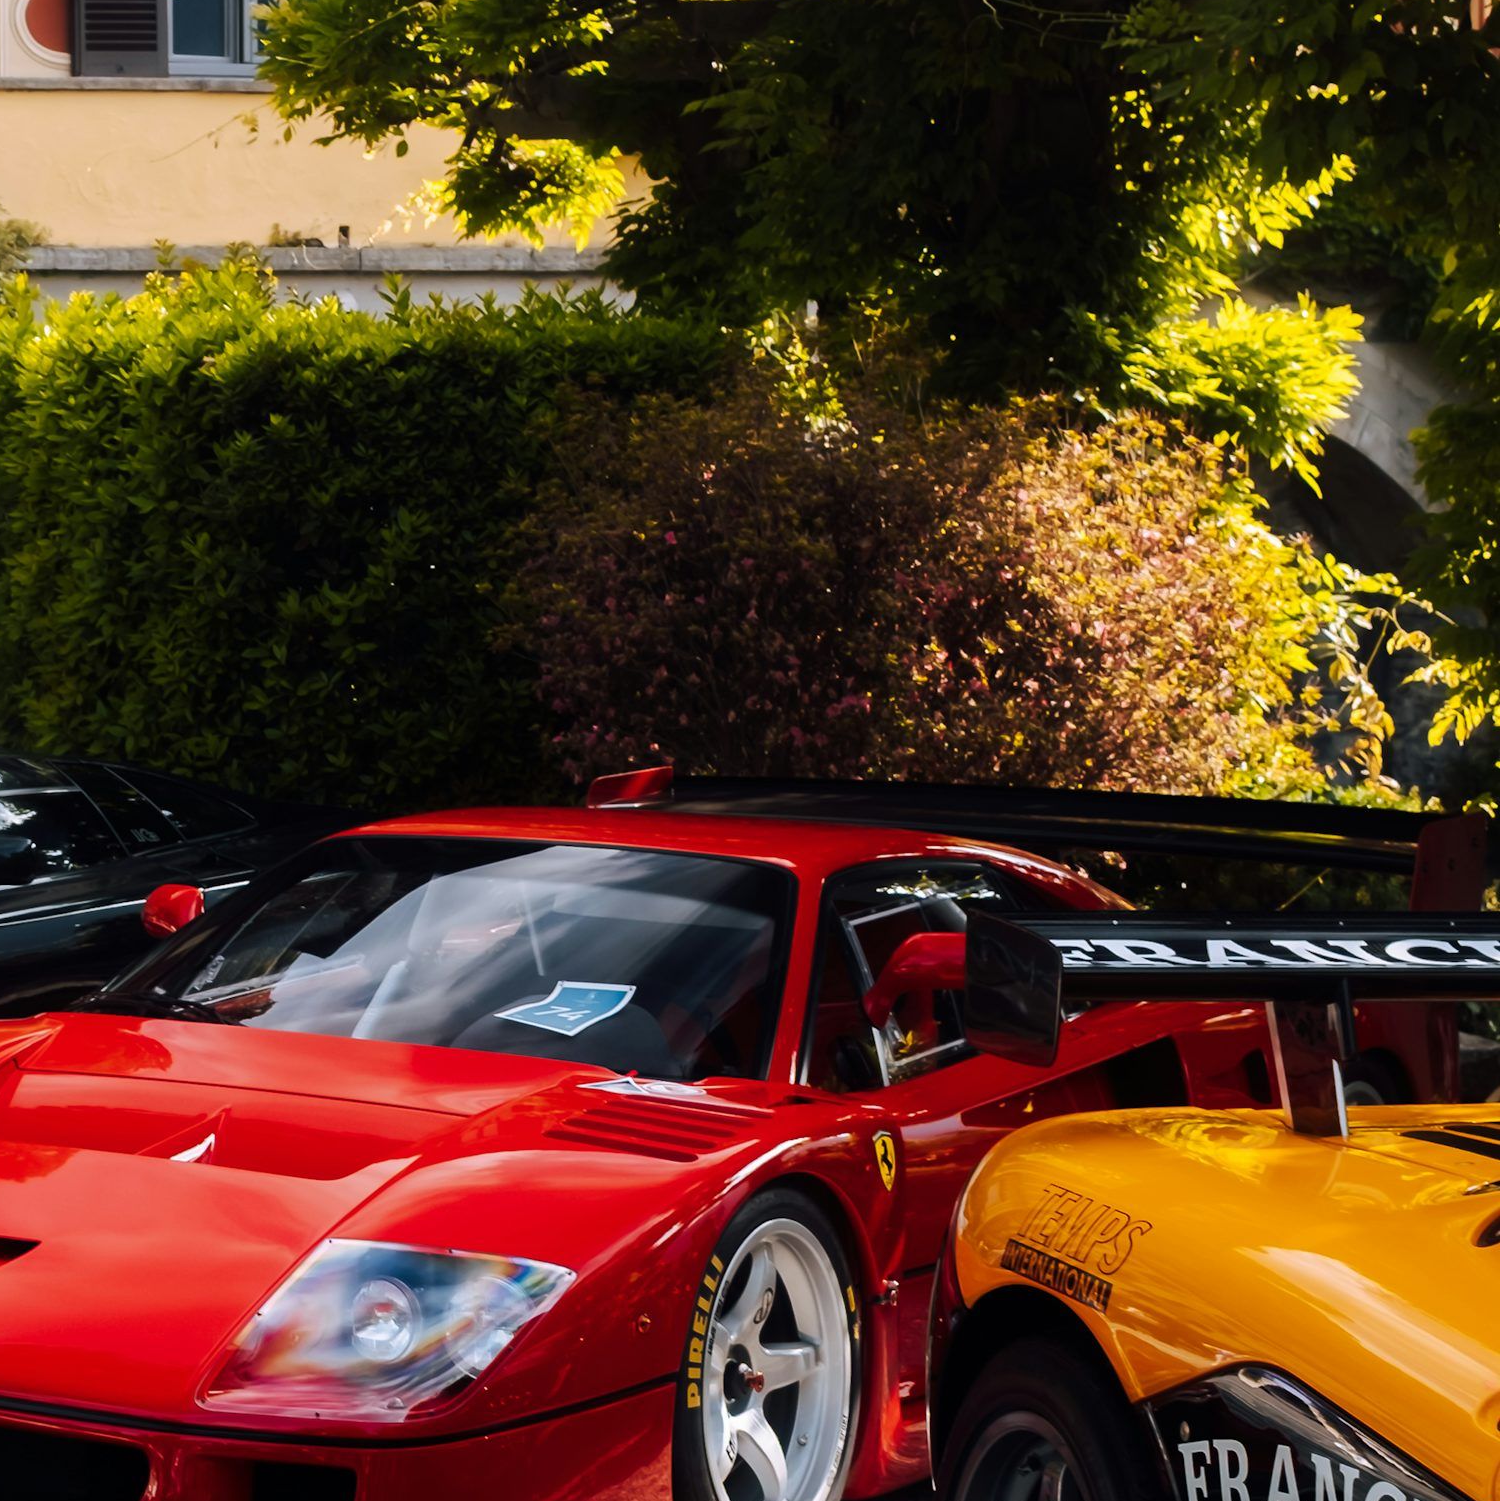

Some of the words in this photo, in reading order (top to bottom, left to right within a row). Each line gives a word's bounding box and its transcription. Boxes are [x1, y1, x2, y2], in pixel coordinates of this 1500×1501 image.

[533, 1006, 591, 1021] 74
[1017, 1183, 1153, 1276] TEMPS
[1002, 1240, 1111, 1314] INTERNATIONAL
[686, 1254, 724, 1409] PIRELLI
